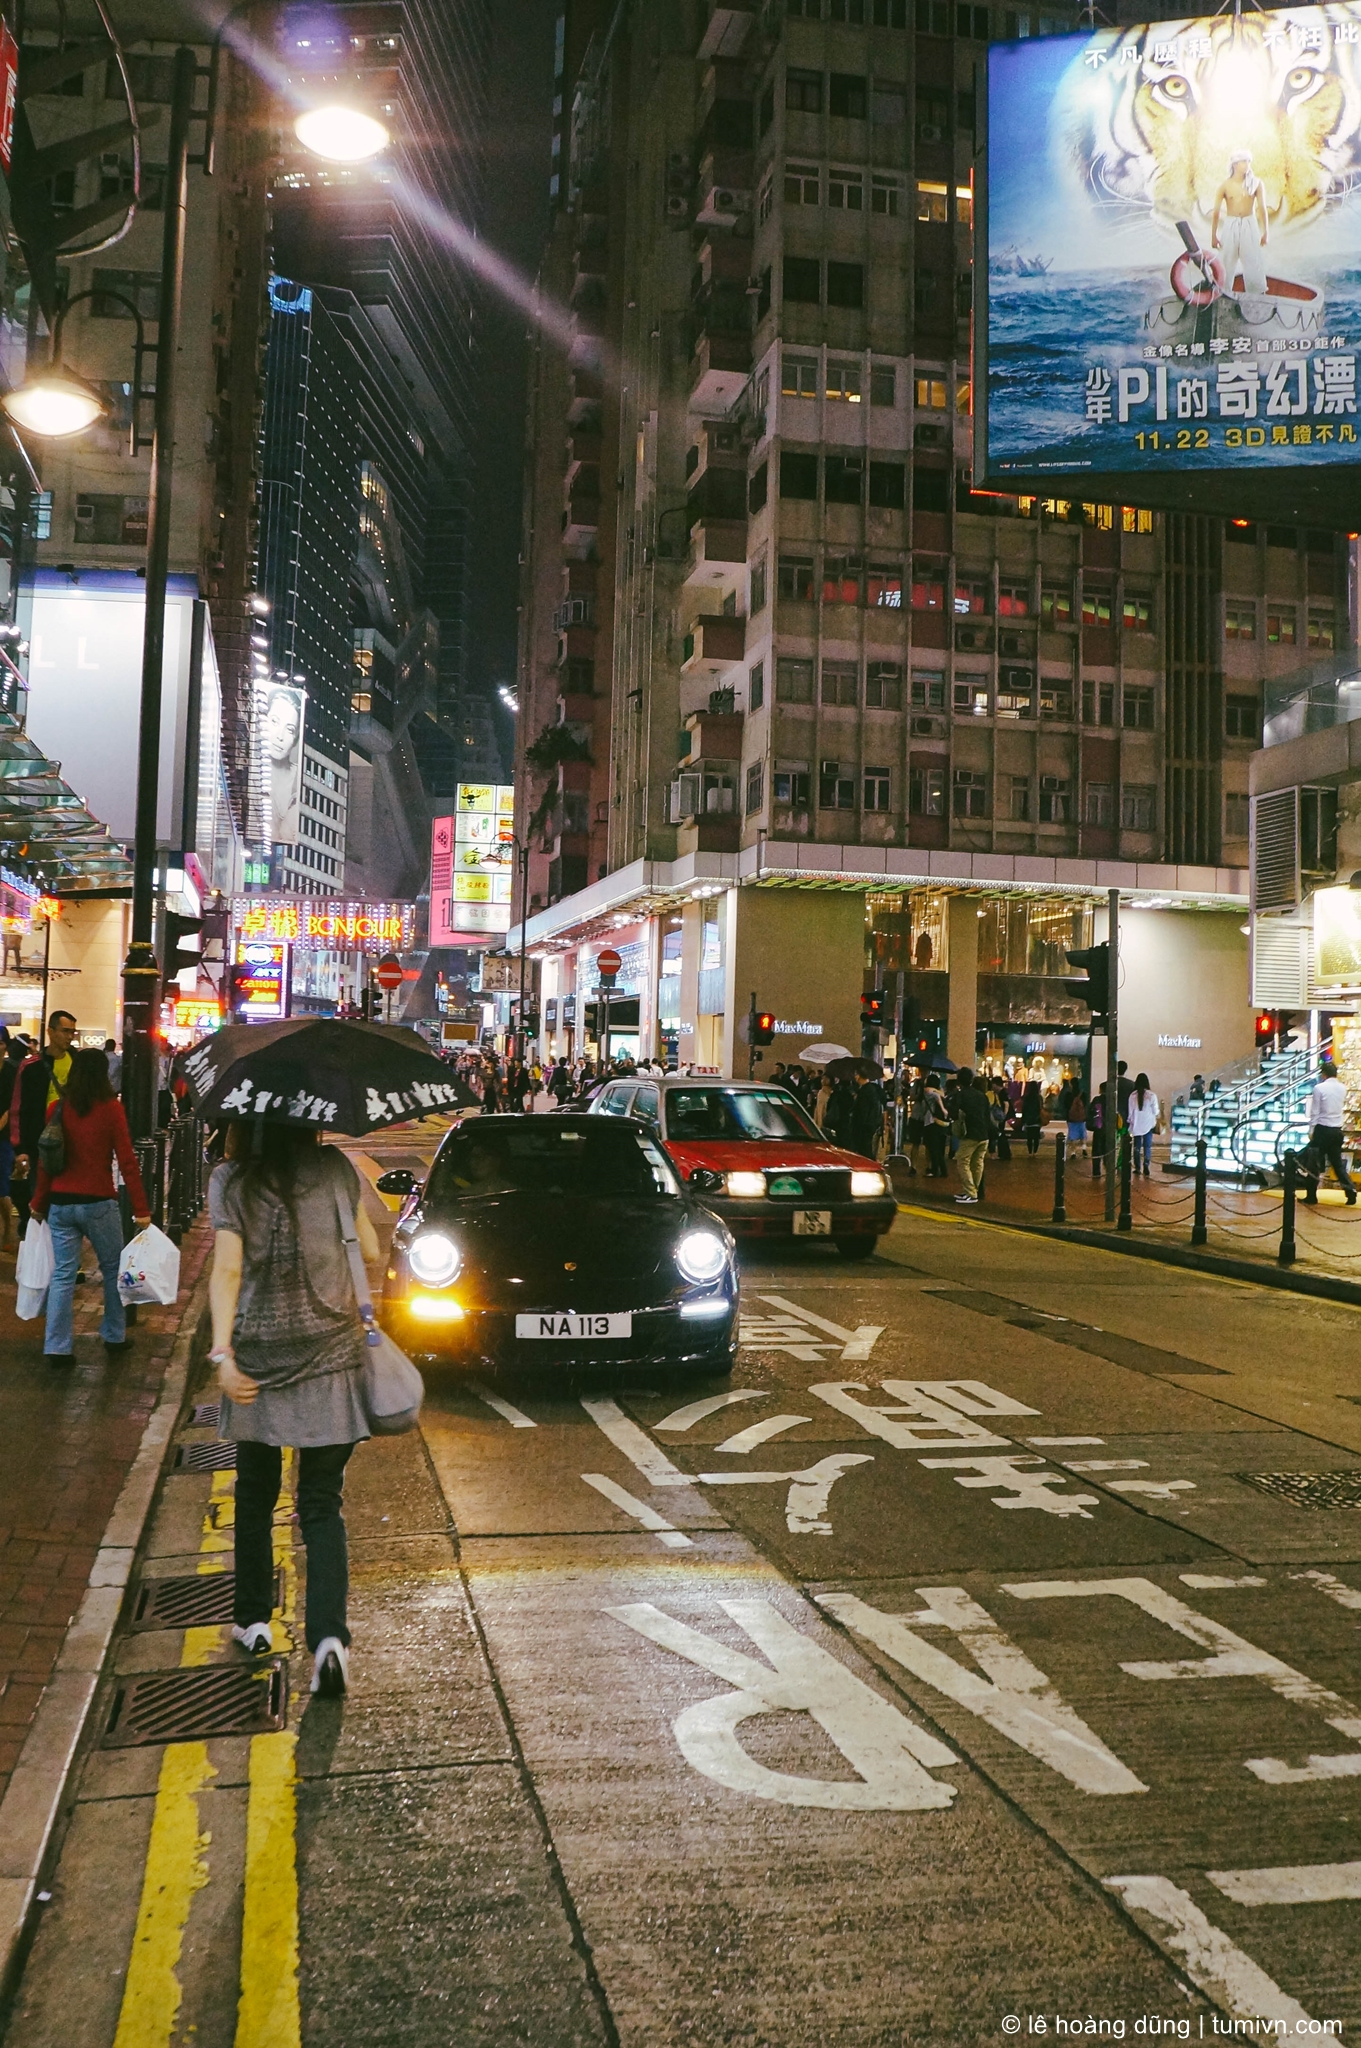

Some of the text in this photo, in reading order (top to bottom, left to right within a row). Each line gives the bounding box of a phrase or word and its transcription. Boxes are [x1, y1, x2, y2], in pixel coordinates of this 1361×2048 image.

[1134, 429, 1210, 450] 11.22
[307, 916, 402, 939] BONJOUR
[773, 1020, 824, 1035] MaxMara
[1157, 1034, 1202, 1048] MaxMara
[697, 1066, 719, 1074] TAXI
[540, 1316, 610, 1336] NA 113
